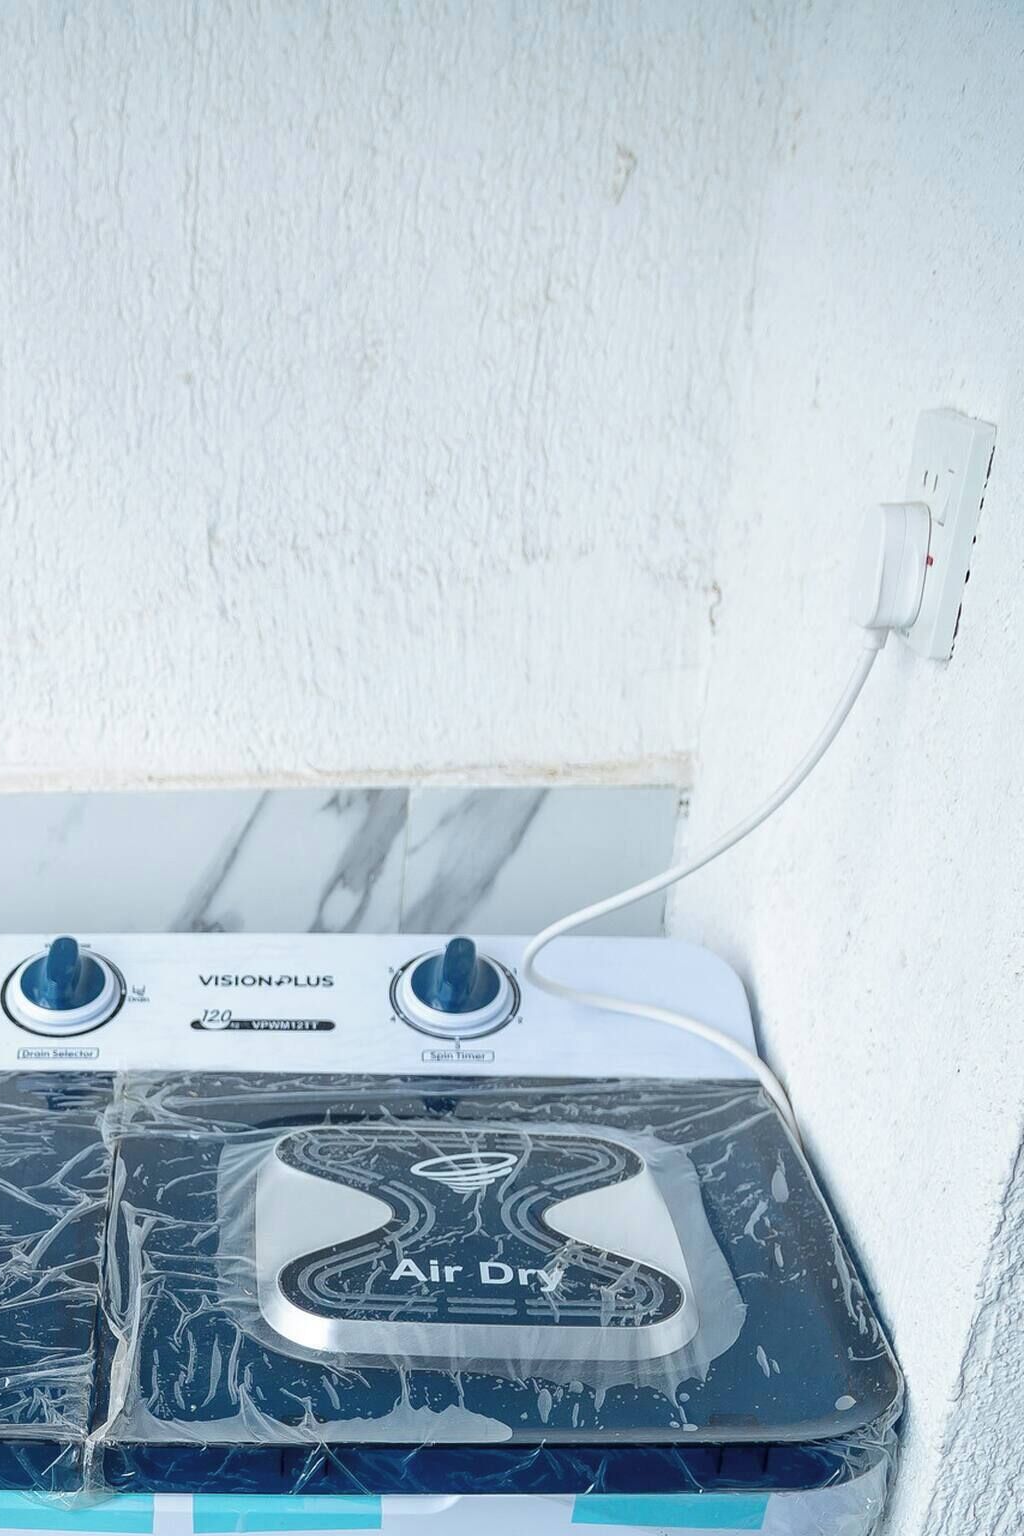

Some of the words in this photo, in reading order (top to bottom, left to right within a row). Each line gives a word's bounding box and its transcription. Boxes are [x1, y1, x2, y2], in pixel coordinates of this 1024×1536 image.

[22, 1049, 50, 1059] Drain
[52, 1049, 93, 1059] Selector
[430, 1051, 454, 1061] Spin
[455, 1050, 485, 1060] Timer
[389, 1258, 463, 1284] Air
[480, 1261, 565, 1293] Dry
